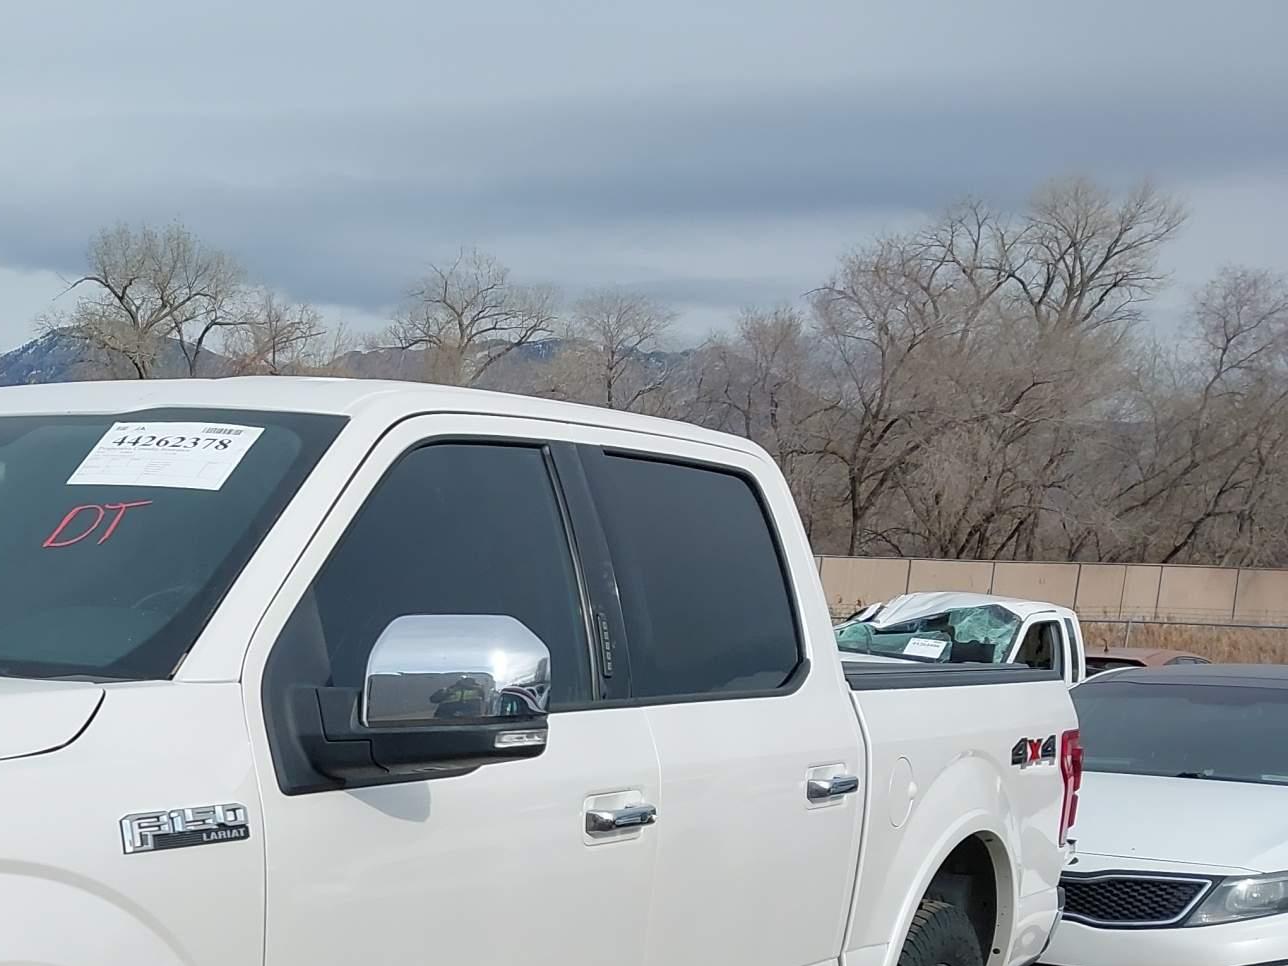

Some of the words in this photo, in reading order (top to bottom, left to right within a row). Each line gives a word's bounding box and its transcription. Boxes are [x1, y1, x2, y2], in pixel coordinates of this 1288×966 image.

[112, 434, 233, 451] 44262378
[42, 500, 153, 547] DT
[202, 826, 247, 842] LARIAT
